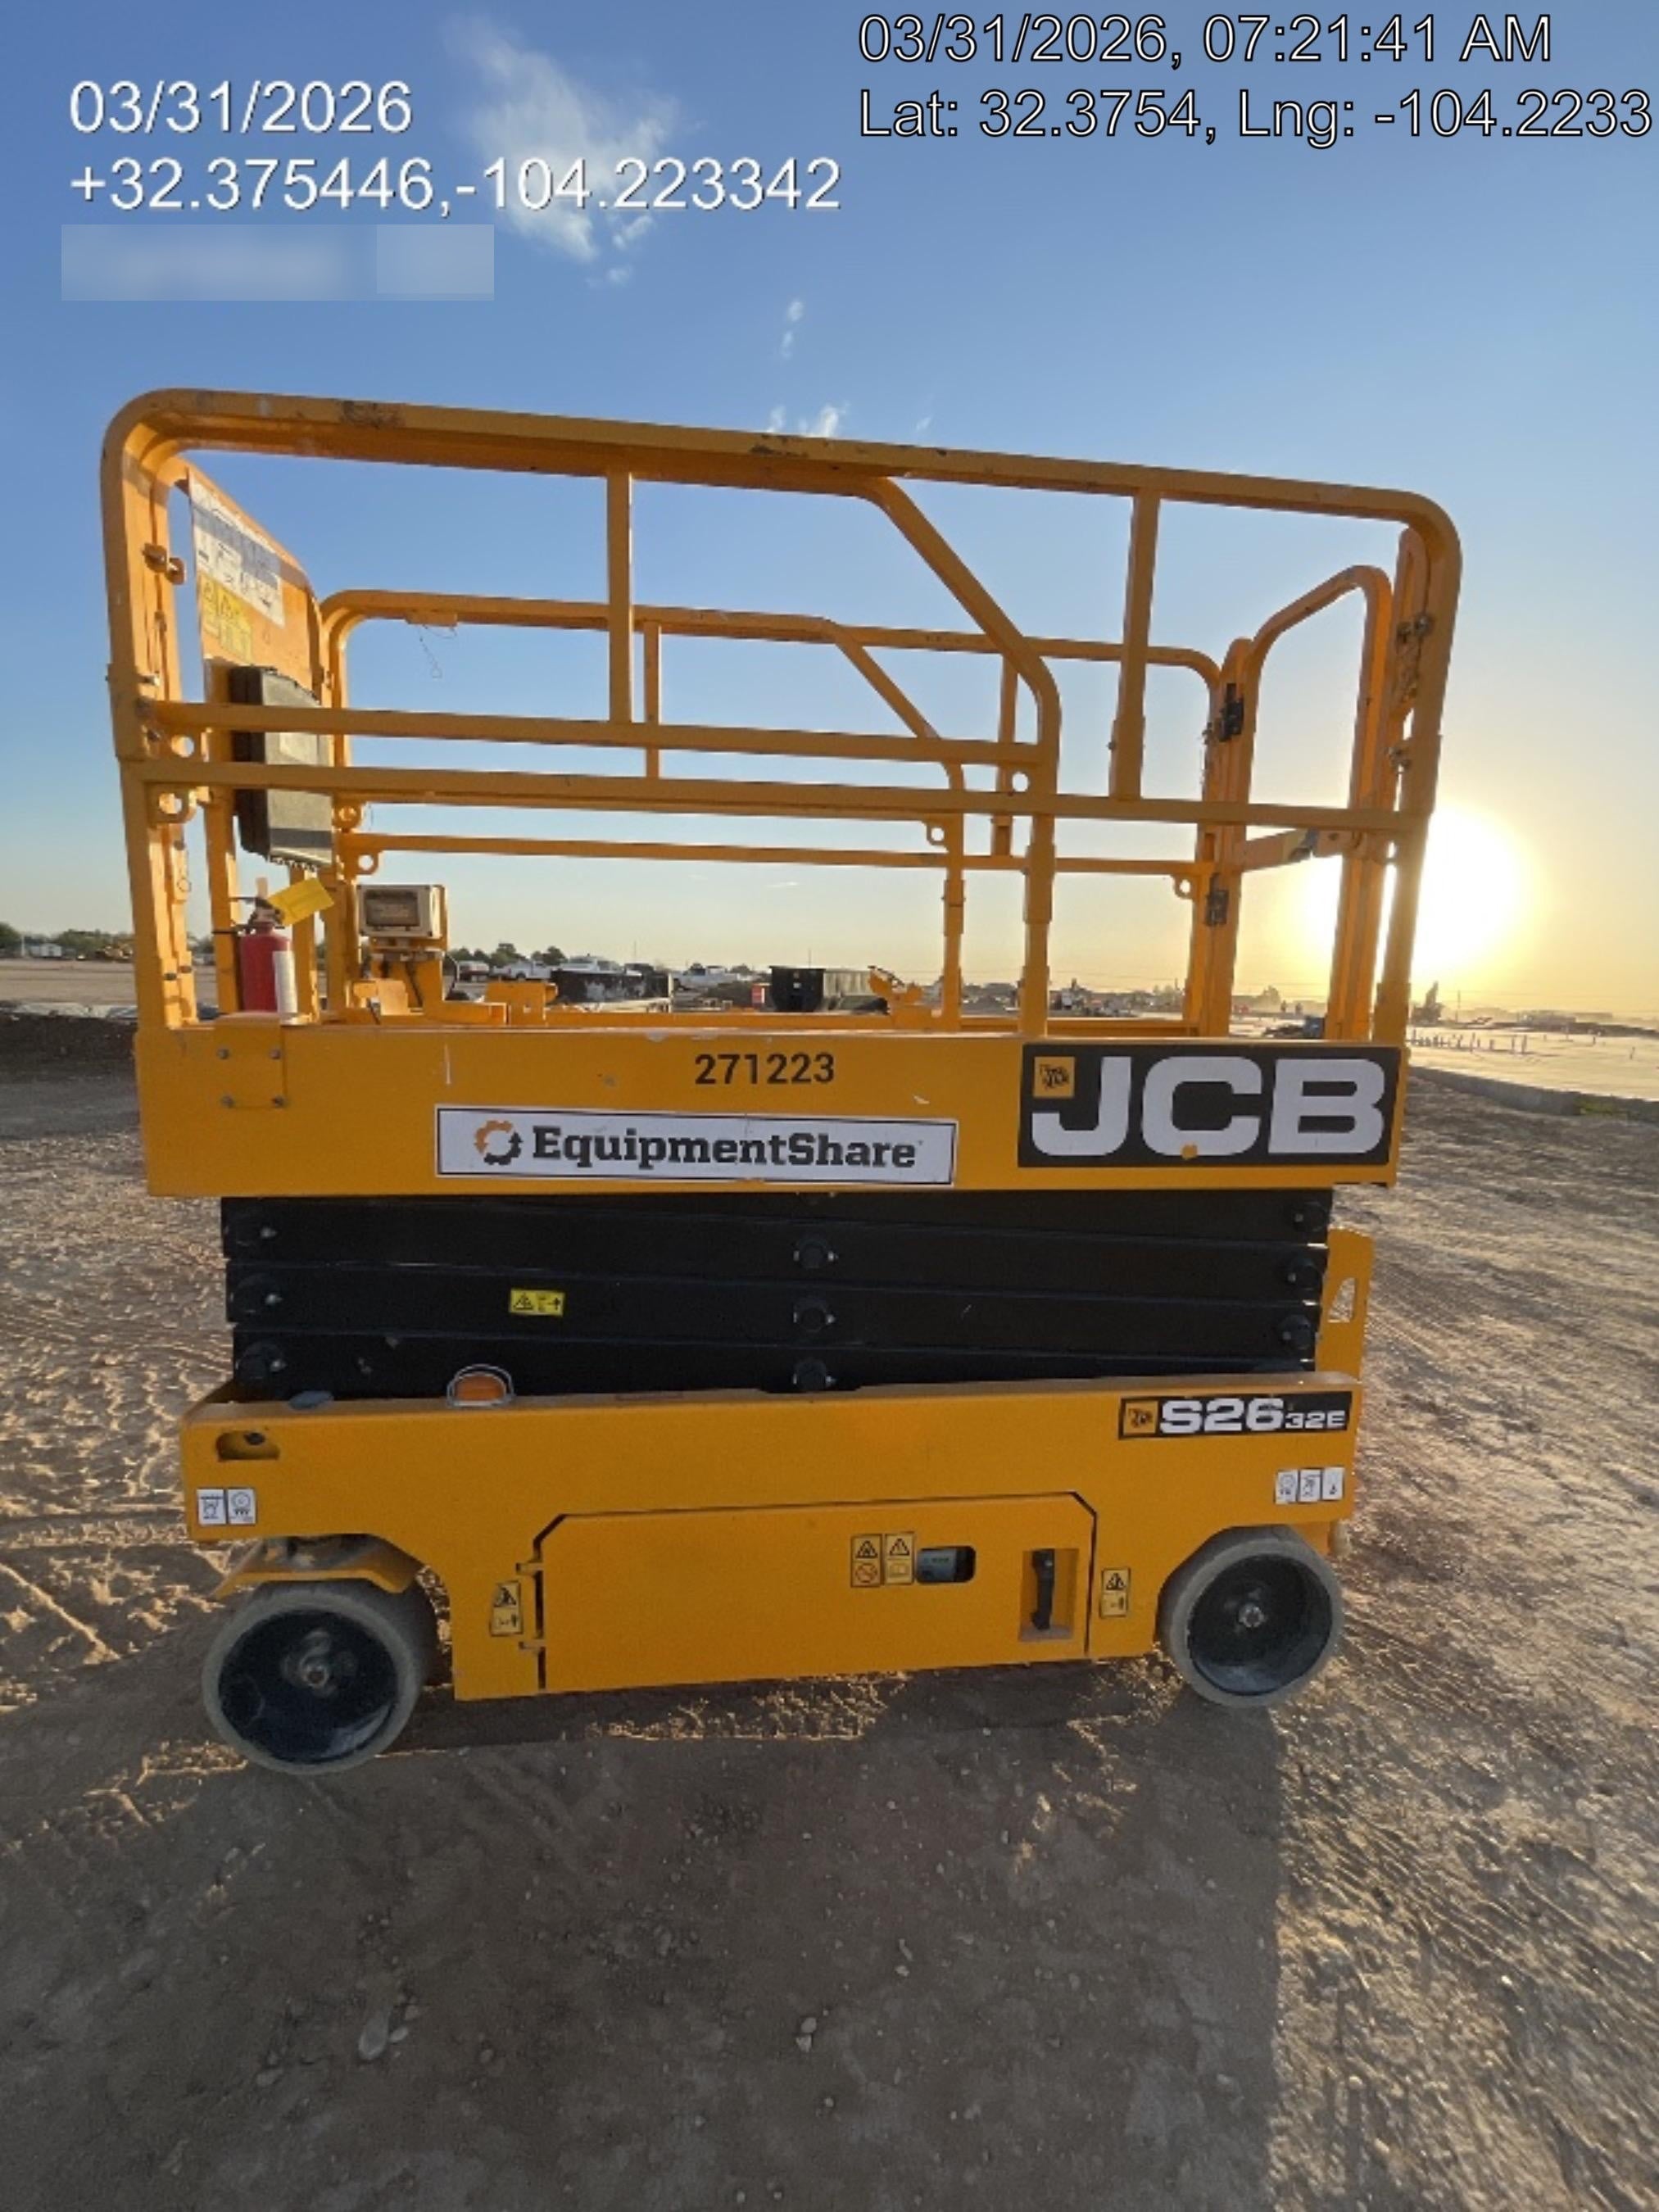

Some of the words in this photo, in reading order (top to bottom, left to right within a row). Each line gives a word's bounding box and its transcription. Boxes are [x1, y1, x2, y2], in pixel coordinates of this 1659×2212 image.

[695, 1052, 835, 1086] 271223
[1031, 1055, 1386, 1157] JCB
[532, 1124, 916, 1170] EquipmentShare
